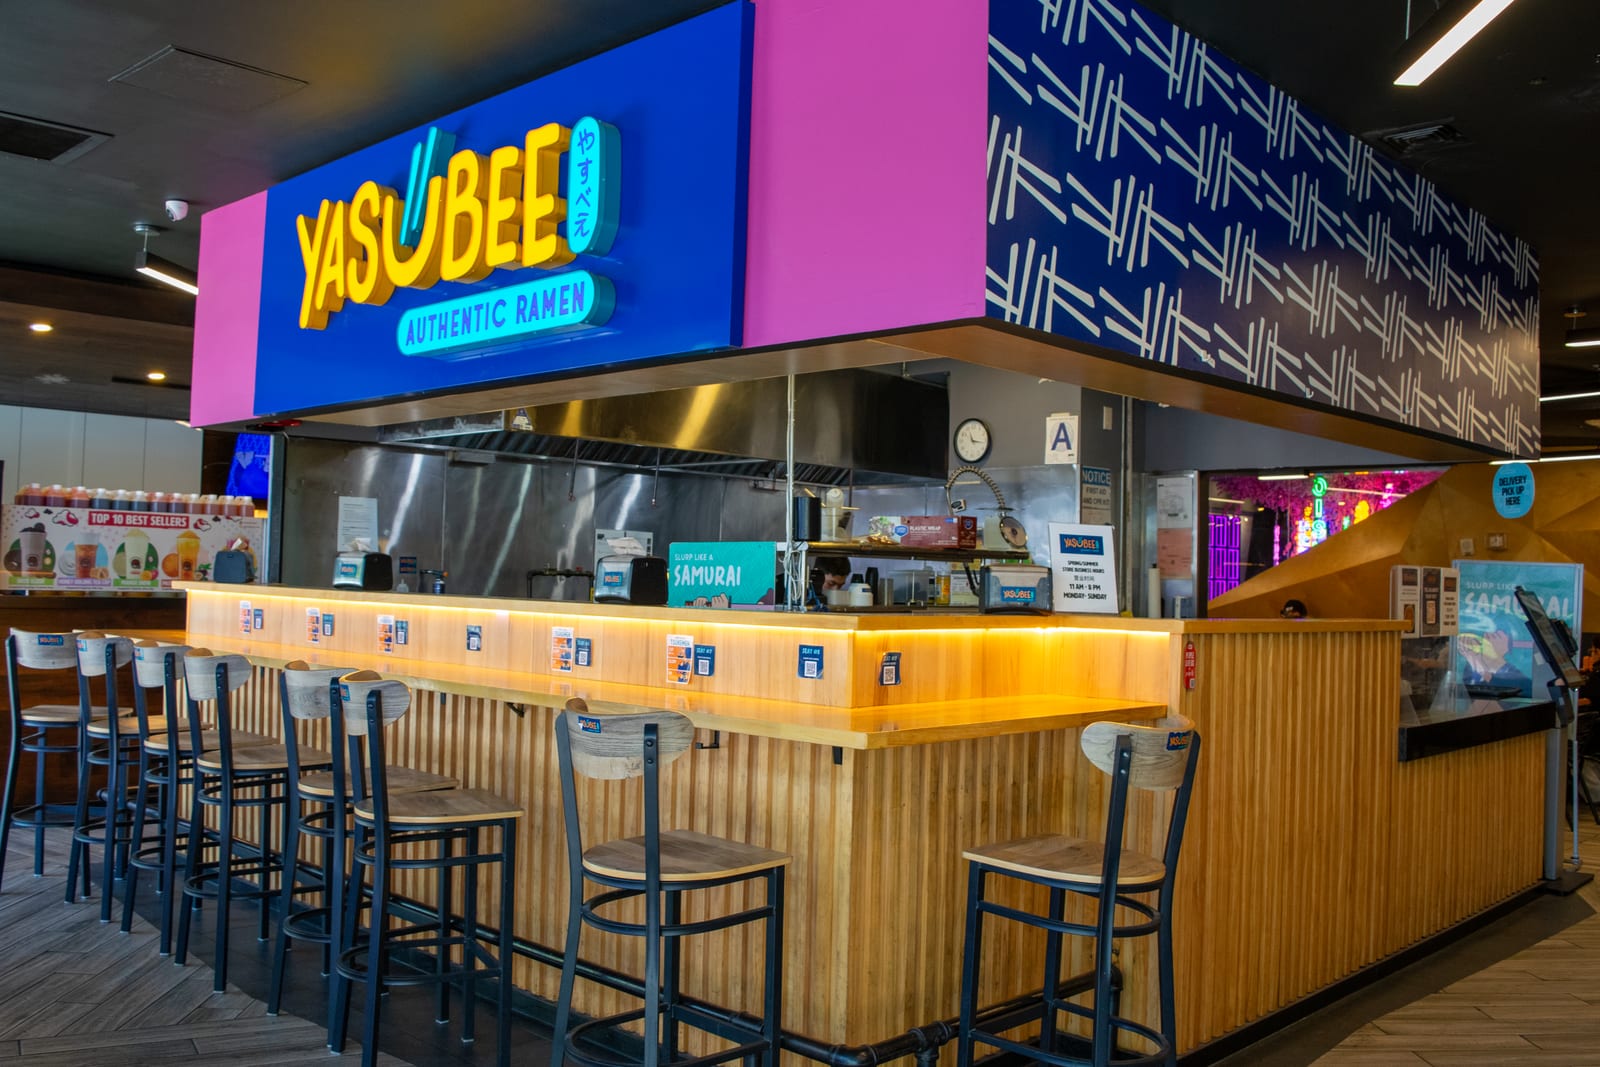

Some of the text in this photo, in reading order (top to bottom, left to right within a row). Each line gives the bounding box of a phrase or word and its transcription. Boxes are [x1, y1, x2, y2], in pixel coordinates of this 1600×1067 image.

[573, 127, 595, 238] やすべえ
[296, 122, 567, 330] YASUBEE
[405, 280, 585, 347] AUTHENTIC RAMEN
[1050, 422, 1072, 451] A
[1082, 469, 1112, 485] NOTICE
[1498, 475, 1528, 486] DELIVERY
[1501, 486, 1525, 496] PICK UP
[1505, 496, 1521, 506] HERE
[91, 513, 187, 527] TOP 10 BEST SELLERS
[1063, 537, 1097, 549] YASUBEE
[674, 553, 714, 561] SLURP LIKE A
[674, 564, 742, 587] SAMURAI
[1465, 581, 1495, 590] SLURP
